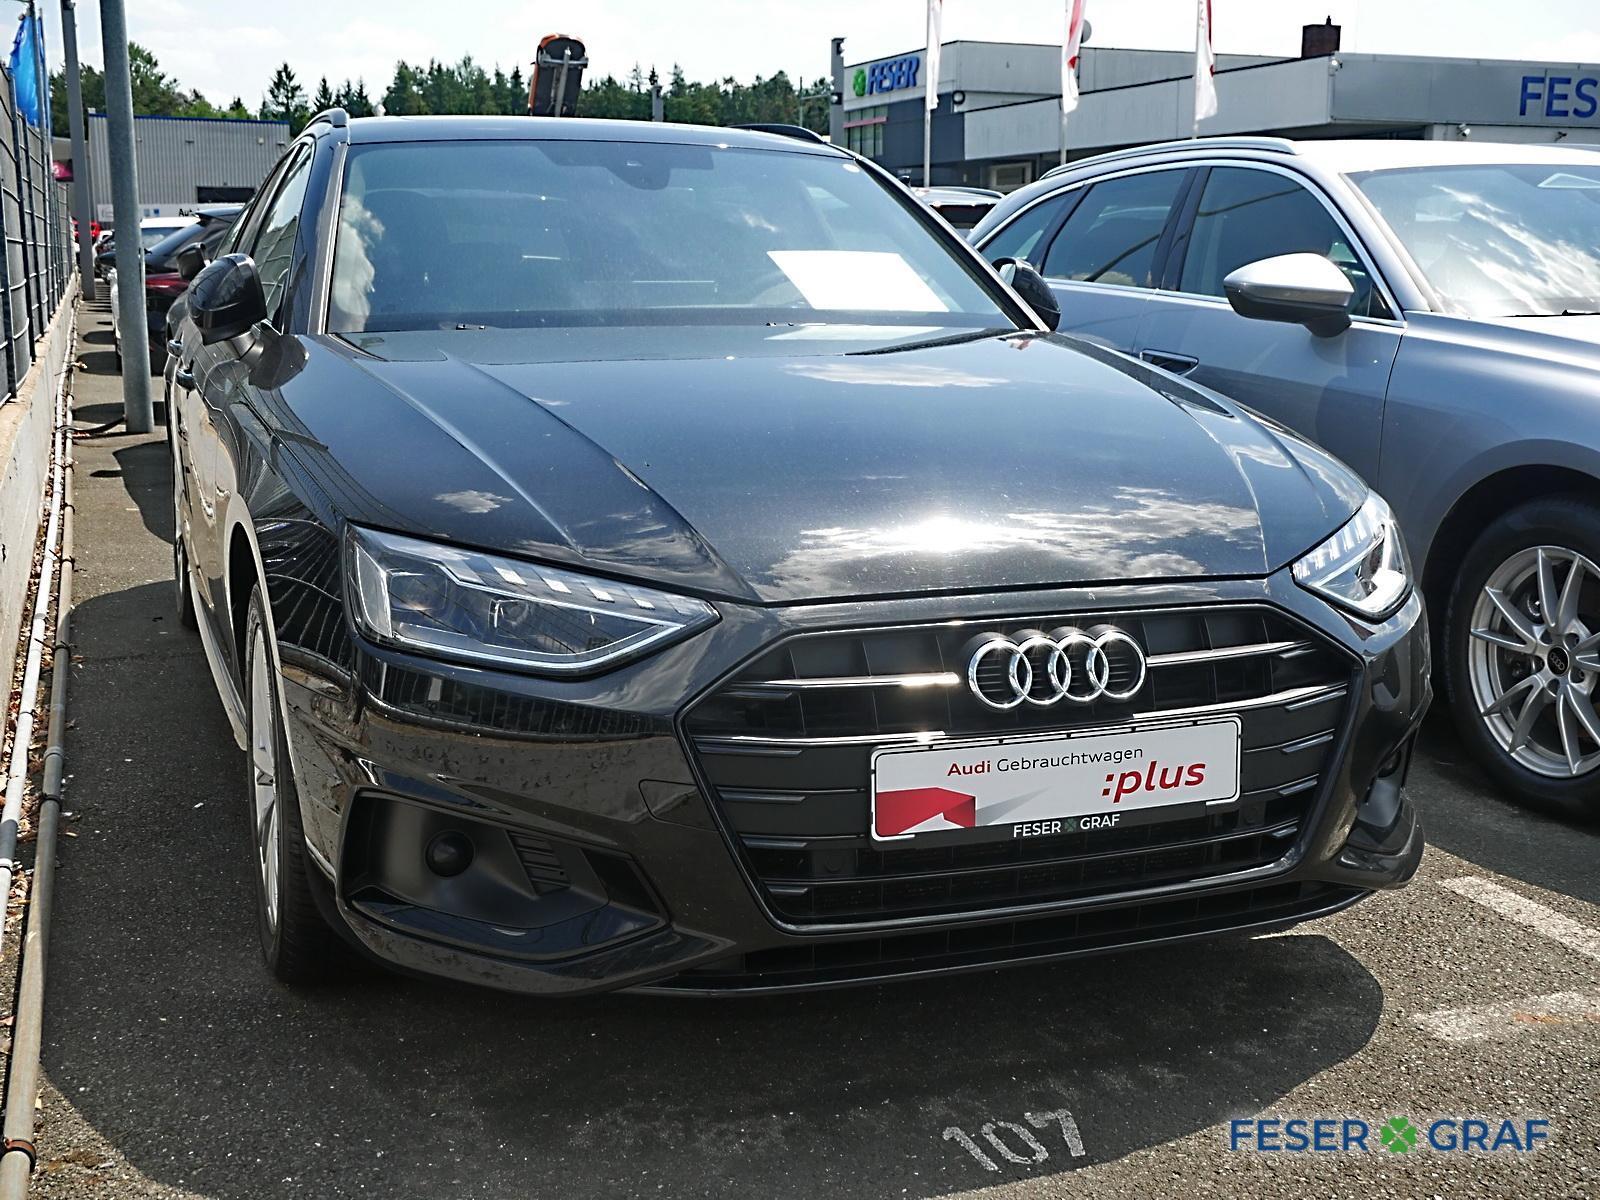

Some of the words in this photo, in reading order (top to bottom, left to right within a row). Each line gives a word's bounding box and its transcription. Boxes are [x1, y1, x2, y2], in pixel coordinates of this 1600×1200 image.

[867, 57, 919, 95] FESER
[1519, 76, 1598, 118] FES
[947, 763, 991, 776] Audi
[996, 747, 1143, 773] Gebrauchtwagen
[1013, 820, 1062, 837] FESER
[1080, 814, 1120, 831] GRAF
[942, 1108, 1086, 1171] 107
